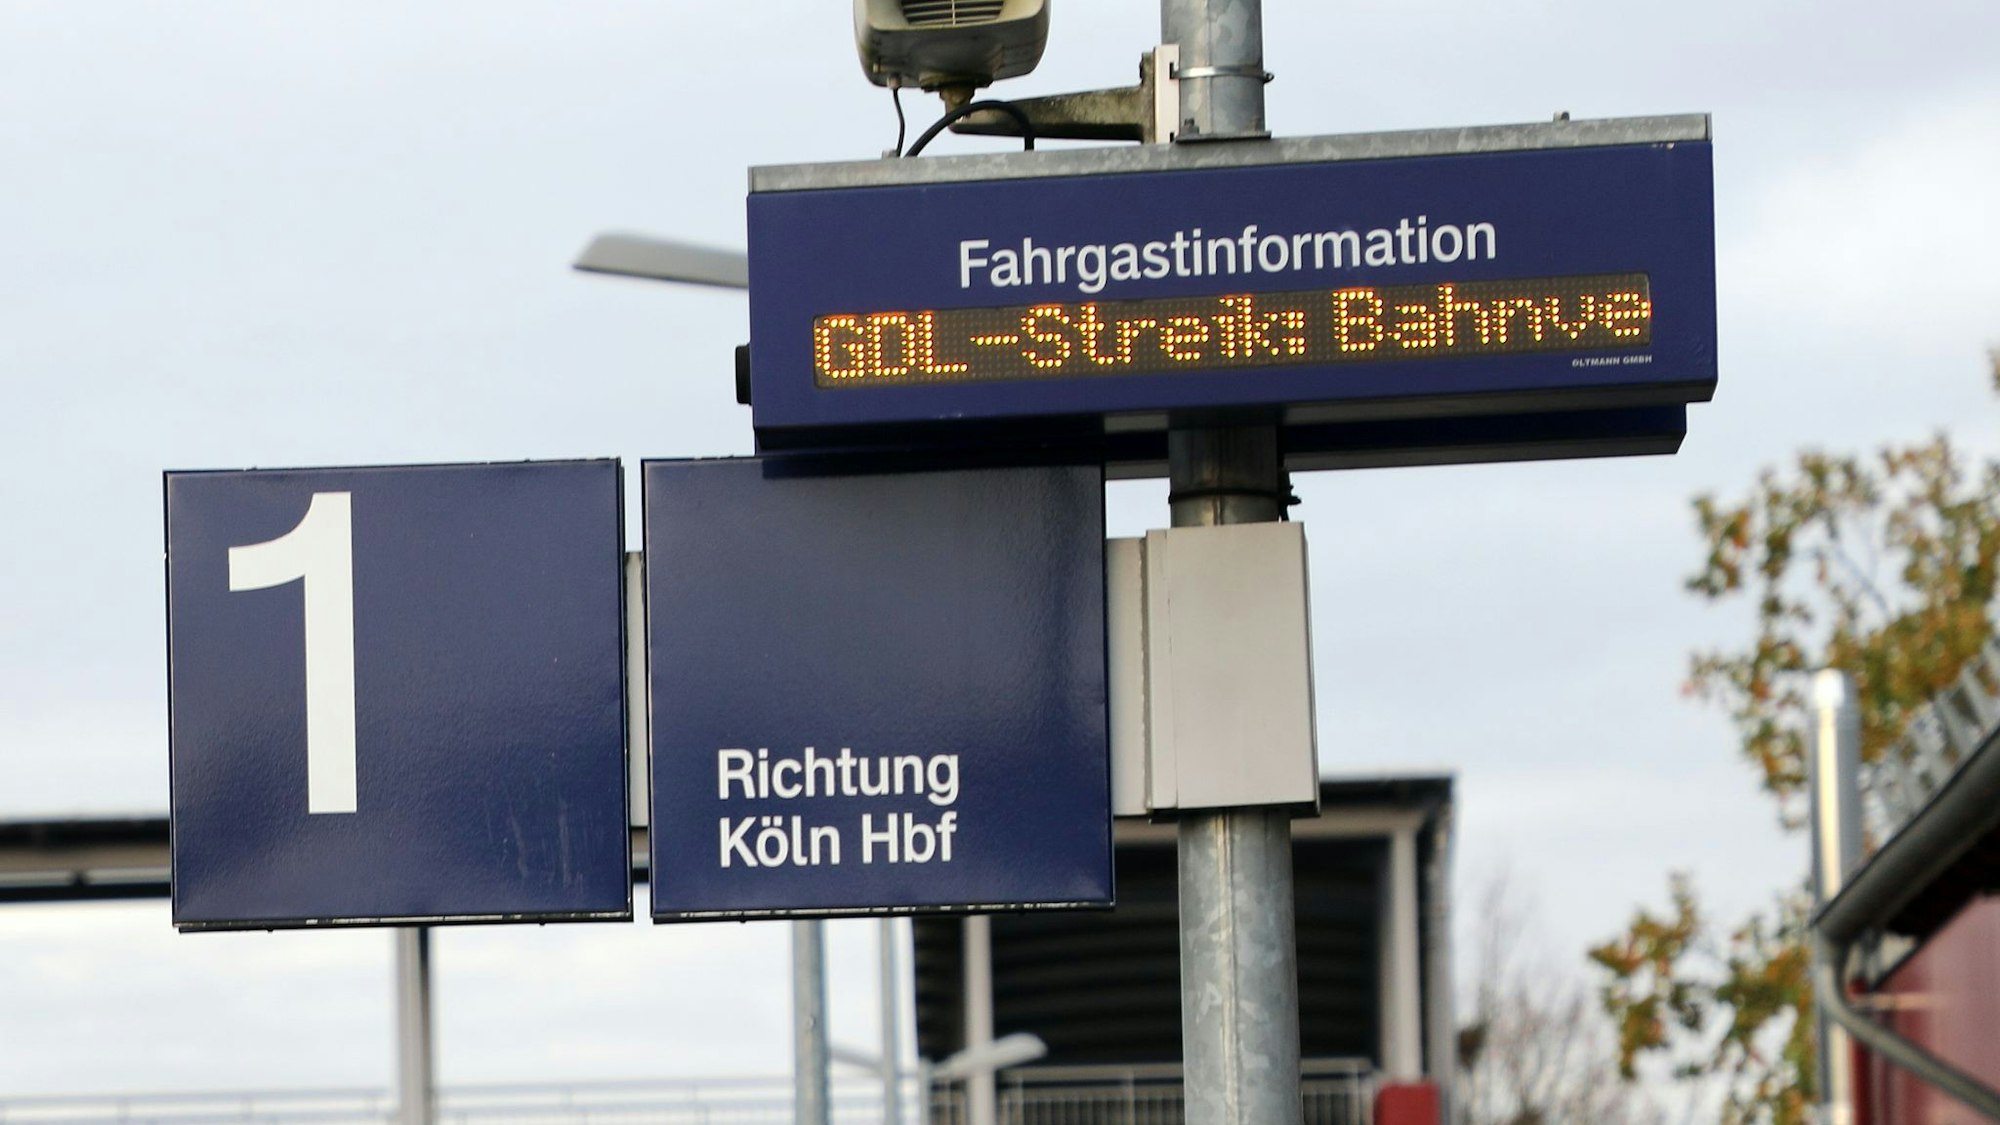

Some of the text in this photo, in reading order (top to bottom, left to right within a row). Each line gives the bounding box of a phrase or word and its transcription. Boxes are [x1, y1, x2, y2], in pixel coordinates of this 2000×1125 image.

[958, 216, 1496, 294] Fahrgastinformation
[814, 284, 1651, 379] GDL-Streik: Bahnve
[227, 490, 357, 814] 1
[716, 746, 960, 806] Richtung
[718, 811, 959, 869] Köln Hbf
